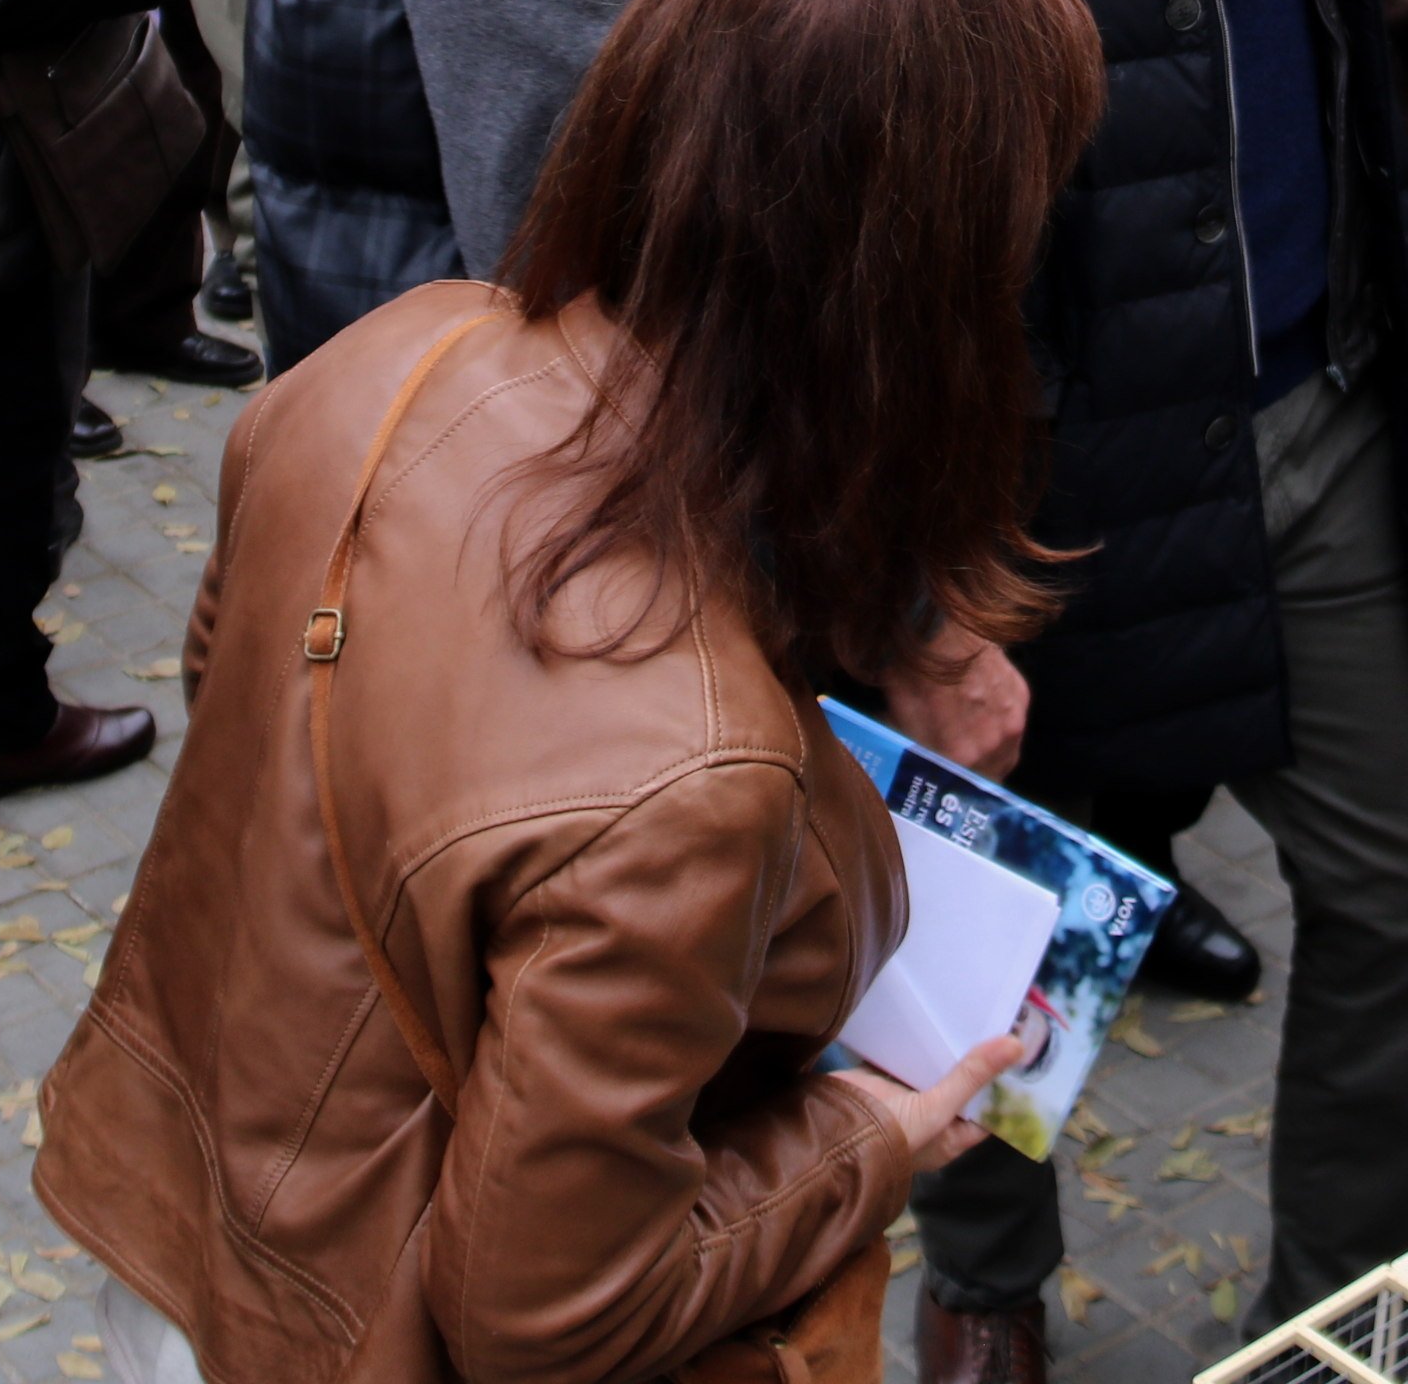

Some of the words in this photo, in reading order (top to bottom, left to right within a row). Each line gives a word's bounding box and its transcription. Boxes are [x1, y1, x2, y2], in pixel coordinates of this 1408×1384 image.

[920, 780, 939, 809] per
[934, 792, 963, 828] és
[1109, 896, 1138, 937] VOTA
